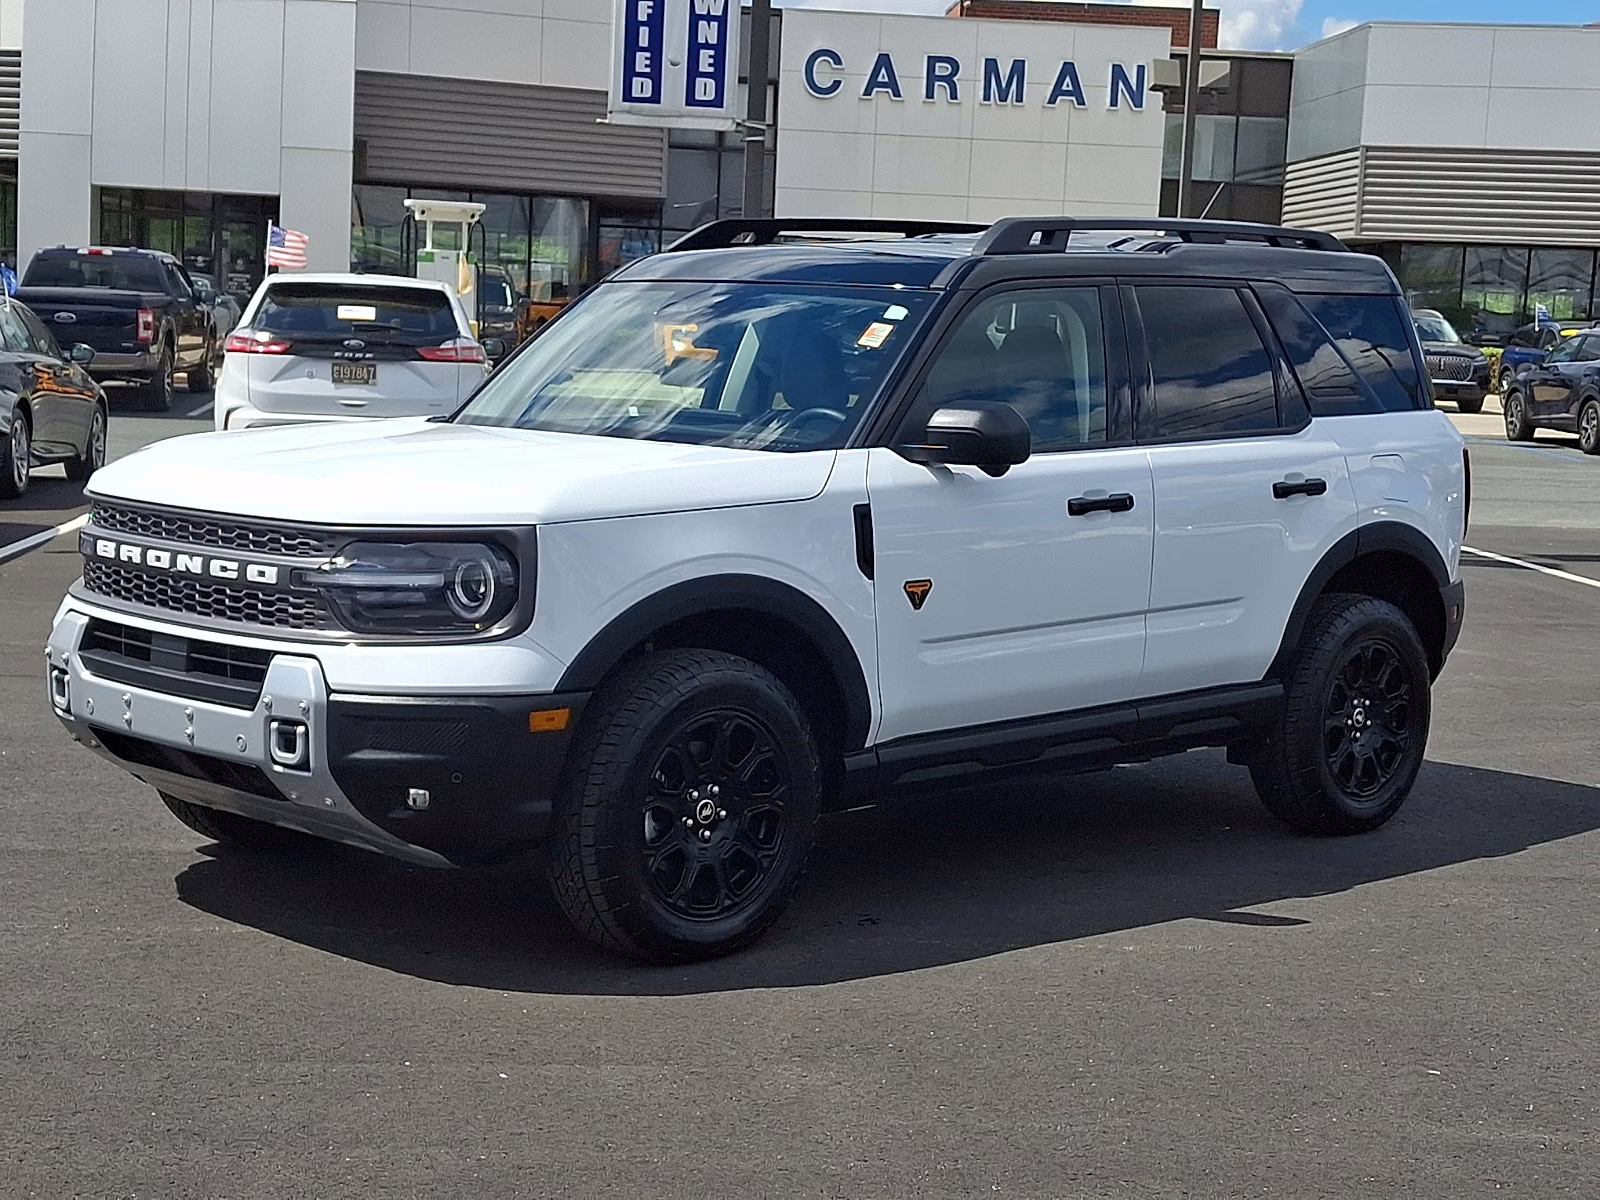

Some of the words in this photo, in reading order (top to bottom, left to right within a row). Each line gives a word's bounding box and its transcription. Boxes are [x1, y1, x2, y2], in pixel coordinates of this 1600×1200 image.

[632, 1, 653, 98] FIED
[803, 48, 1147, 112] CARMAN
[96, 538, 279, 585] BRONCO
